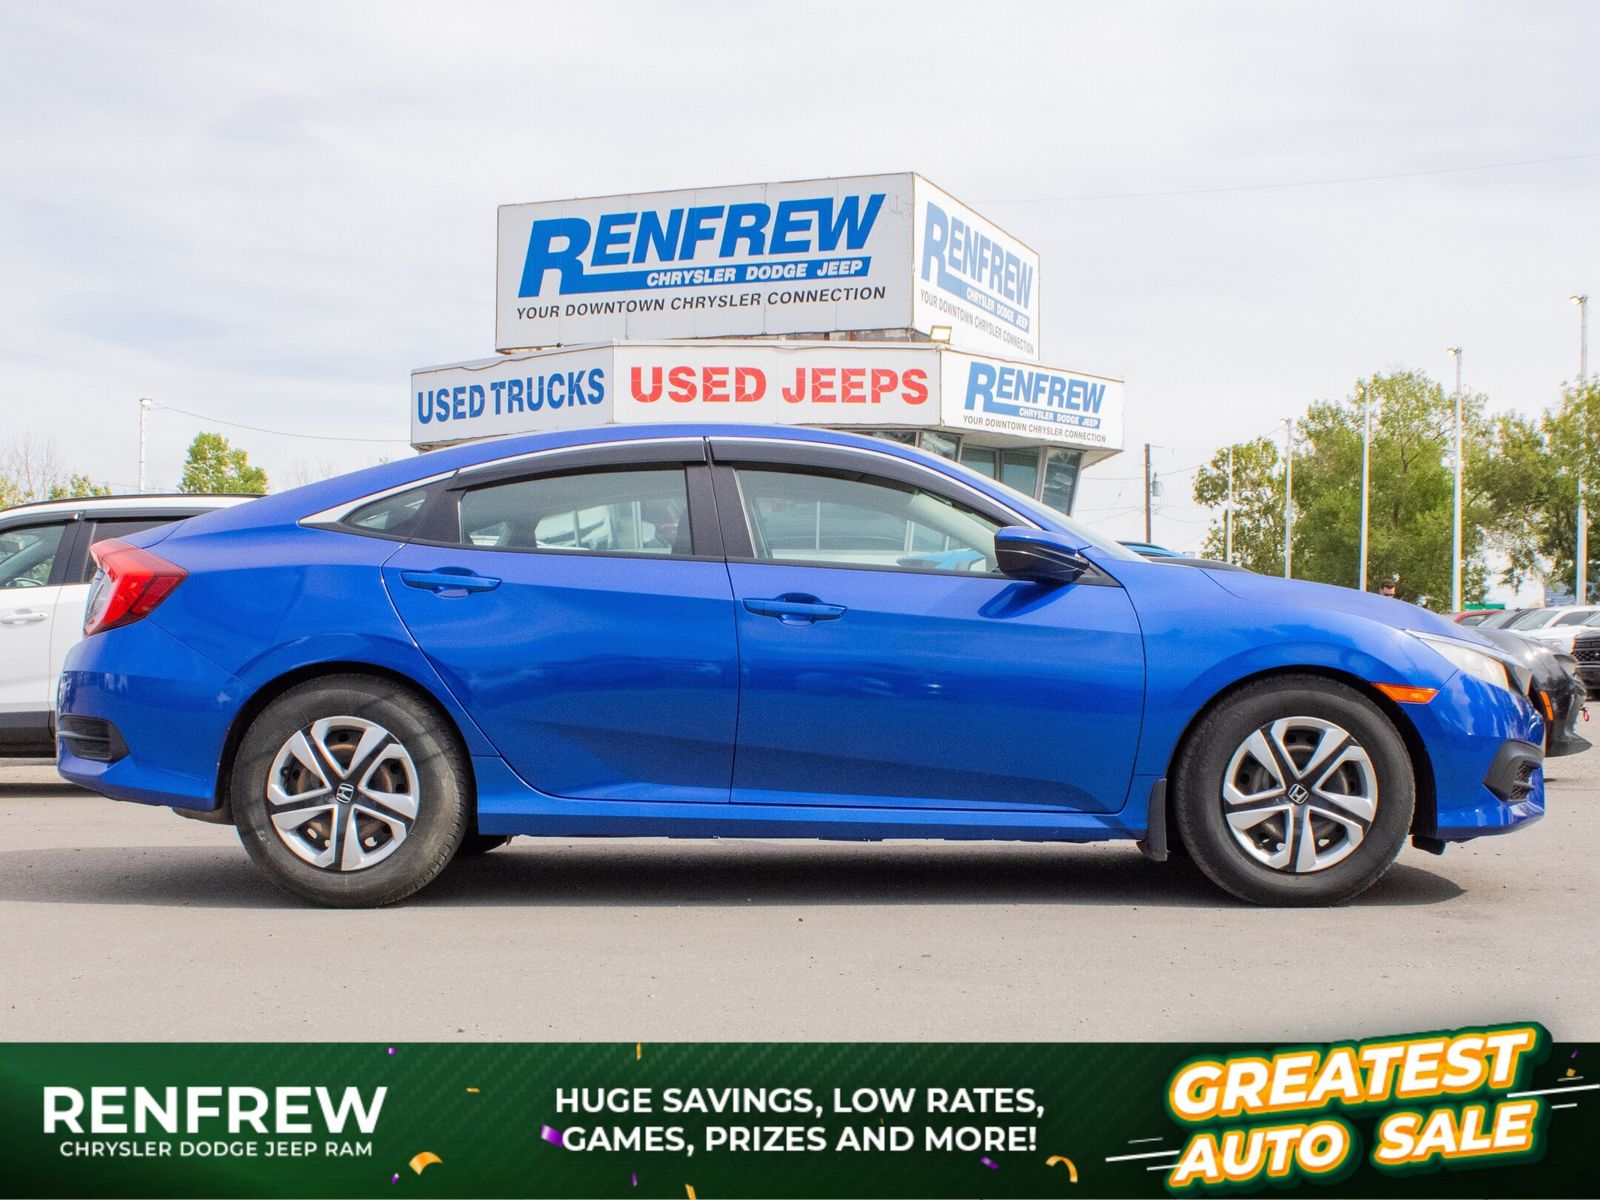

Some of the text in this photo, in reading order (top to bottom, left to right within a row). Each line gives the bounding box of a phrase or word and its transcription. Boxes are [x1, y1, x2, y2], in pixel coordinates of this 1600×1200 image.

[517, 193, 887, 298] RENFREW
[921, 201, 1033, 309] RENFREW
[646, 259, 863, 288] CHRYSLER DODGE JEEP
[516, 286, 887, 320] YOUR DOWNTOWN CHRYSLER CONNECTION
[920, 288, 1034, 355] YOUR DOWNTOWN CHRYSLER CONNECTION
[417, 368, 605, 425] USED TRUCKS
[630, 366, 929, 405] USED JEEPS
[964, 361, 1106, 414] RENFREW
[963, 414, 1106, 443] YOUR DOWNTOWN CHRYSLER CONNECTION
[1019, 407, 1098, 428] CHRYSLER DODGE JEEP
